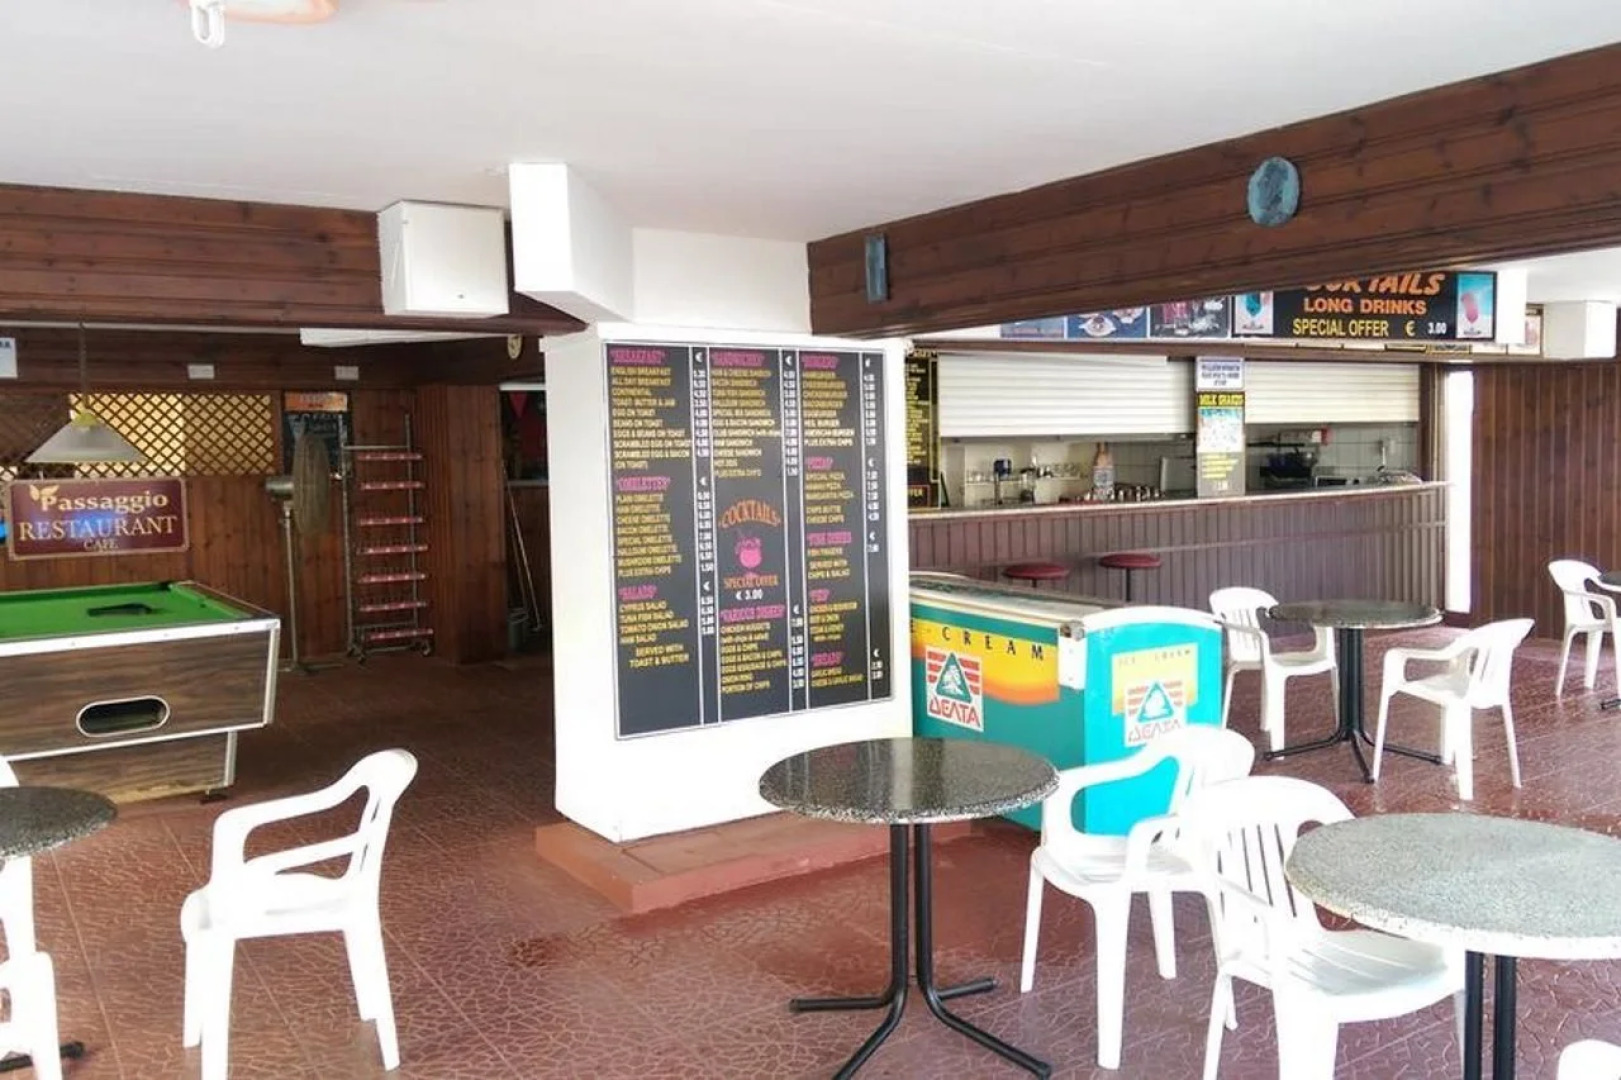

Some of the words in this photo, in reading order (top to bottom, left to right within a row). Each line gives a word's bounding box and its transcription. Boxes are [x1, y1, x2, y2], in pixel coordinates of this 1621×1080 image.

[1304, 297, 1353, 313] LONG
[1360, 299, 1426, 315] DRINKS
[1292, 318, 1346, 336] SPECIAL
[1349, 319, 1389, 337] OFFER
[1406, 320, 1415, 336] €
[1428, 322, 1447, 335] 3.00
[41, 490, 168, 514] Passaggio
[19, 516, 177, 541] RESTAURANT
[942, 626, 1044, 661] CREAM
